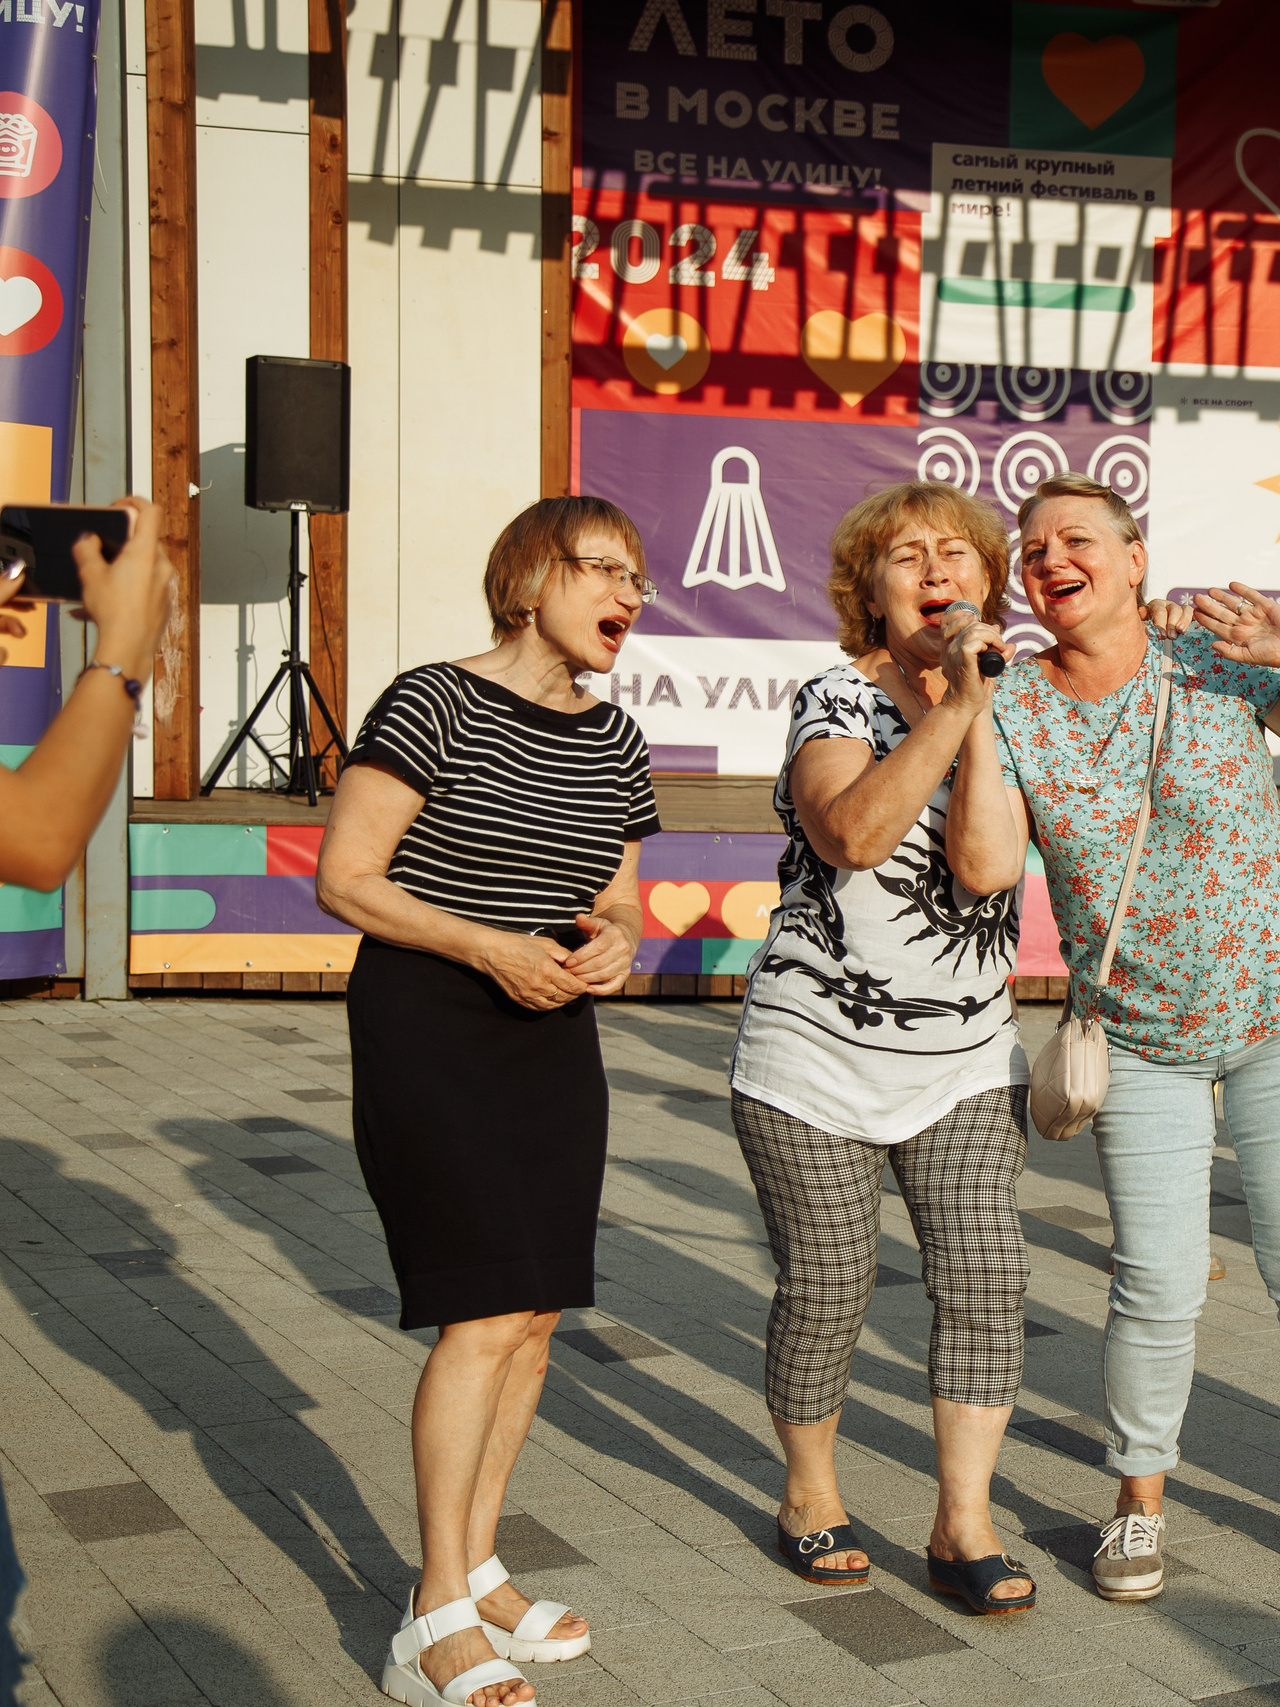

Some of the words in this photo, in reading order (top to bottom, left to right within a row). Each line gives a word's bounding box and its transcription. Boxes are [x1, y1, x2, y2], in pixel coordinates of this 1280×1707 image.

[628, 0, 895, 73] ЛЕТО
[616, 82, 650, 120] В
[667, 86, 900, 140] МОСКВЕ
[634, 149, 698, 176] ВСЕ
[707, 155, 753, 180] НА
[761, 159, 882, 190] УЛИЦУ!
[952, 153, 1018, 170] самый
[1025, 157, 1115, 176] крупный
[951, 177, 1024, 194] летний
[1030, 180, 1139, 201] фестиваль
[1144, 190, 1155, 202] в
[951, 201, 1011, 218] мире!
[571, 214, 775, 291] 2024
[1193, 398, 1209, 406] ВСЕ
[1225, 399, 1254, 407] СПОРТ
[610, 673, 682, 708] НА
